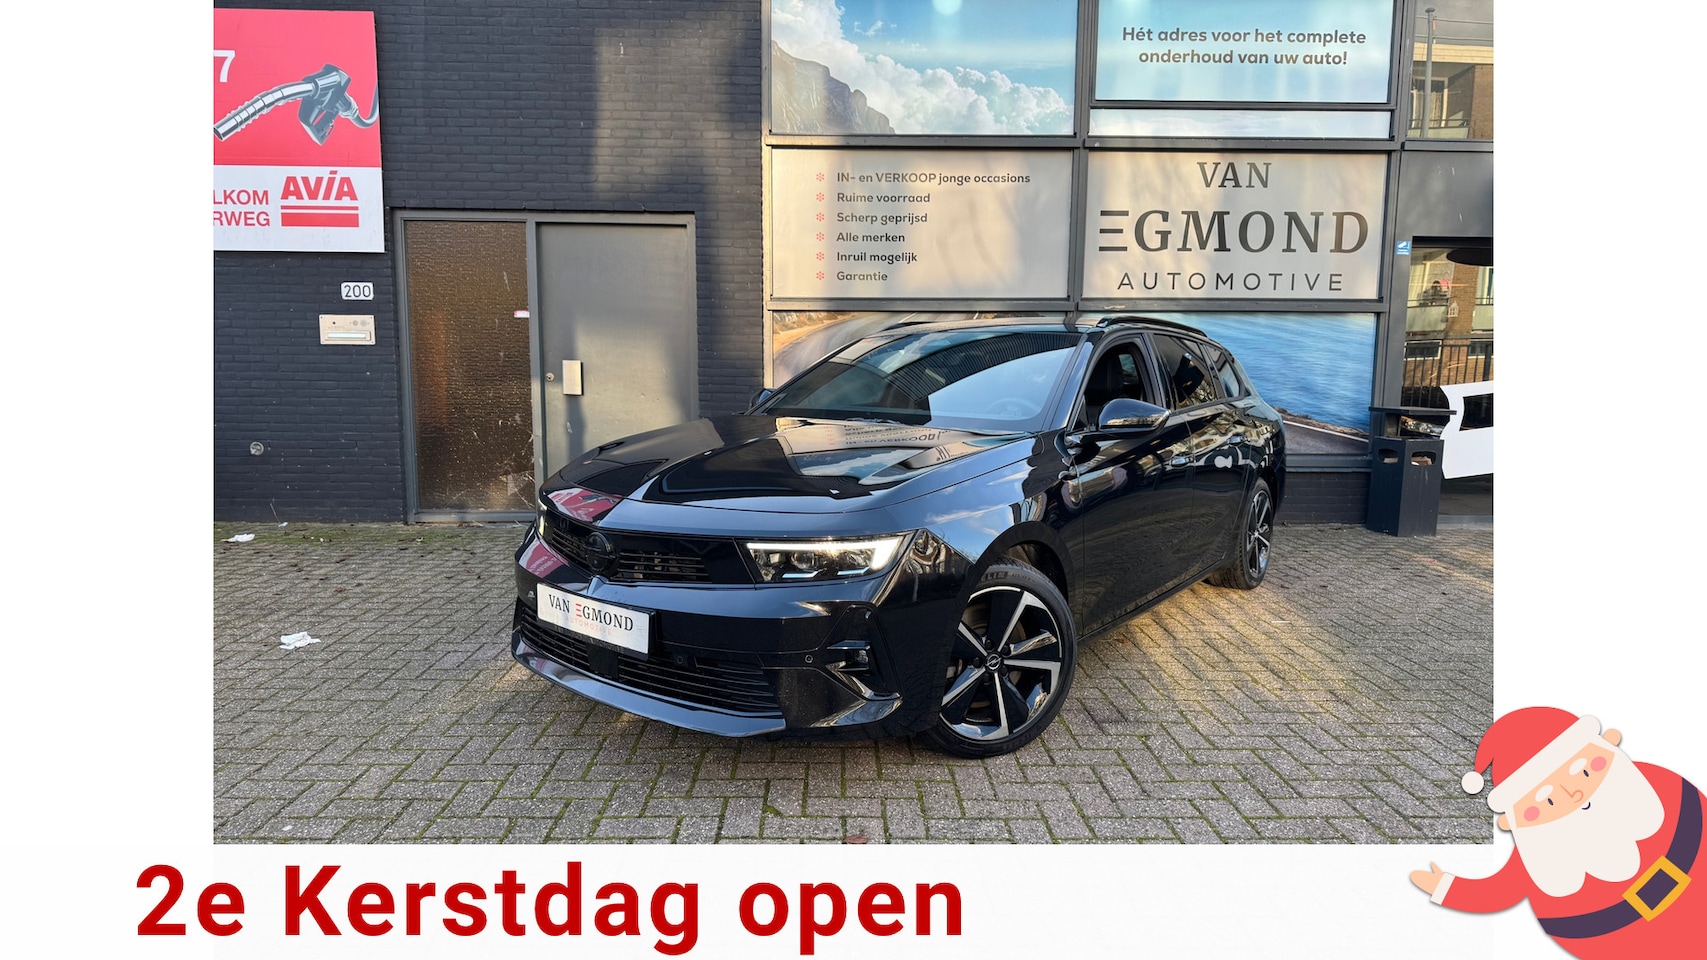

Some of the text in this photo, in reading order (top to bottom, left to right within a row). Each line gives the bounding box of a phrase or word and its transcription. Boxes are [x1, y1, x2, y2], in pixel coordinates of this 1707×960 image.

[1122, 26, 1367, 48] Hét adres voor het complete
[1138, 49, 1348, 66] onderhoud van uw auto!
[837, 172, 1031, 186] IN- en VERKOOP jonge occasions
[1197, 161, 1272, 189] VAN
[280, 170, 359, 201] AVIA
[837, 192, 931, 203] Ruime voorraad
[837, 211, 928, 227] Scherp geprijsd
[836, 232, 905, 243] Alle merken
[1098, 209, 1369, 254] EGMOND
[837, 251, 918, 266] Inruil mogelijk
[836, 271, 888, 282] Garantie
[1117, 271, 1344, 292] AUTOMOTIVE
[343, 284, 371, 298] 200
[548, 593, 634, 632] VAN EGMOND
